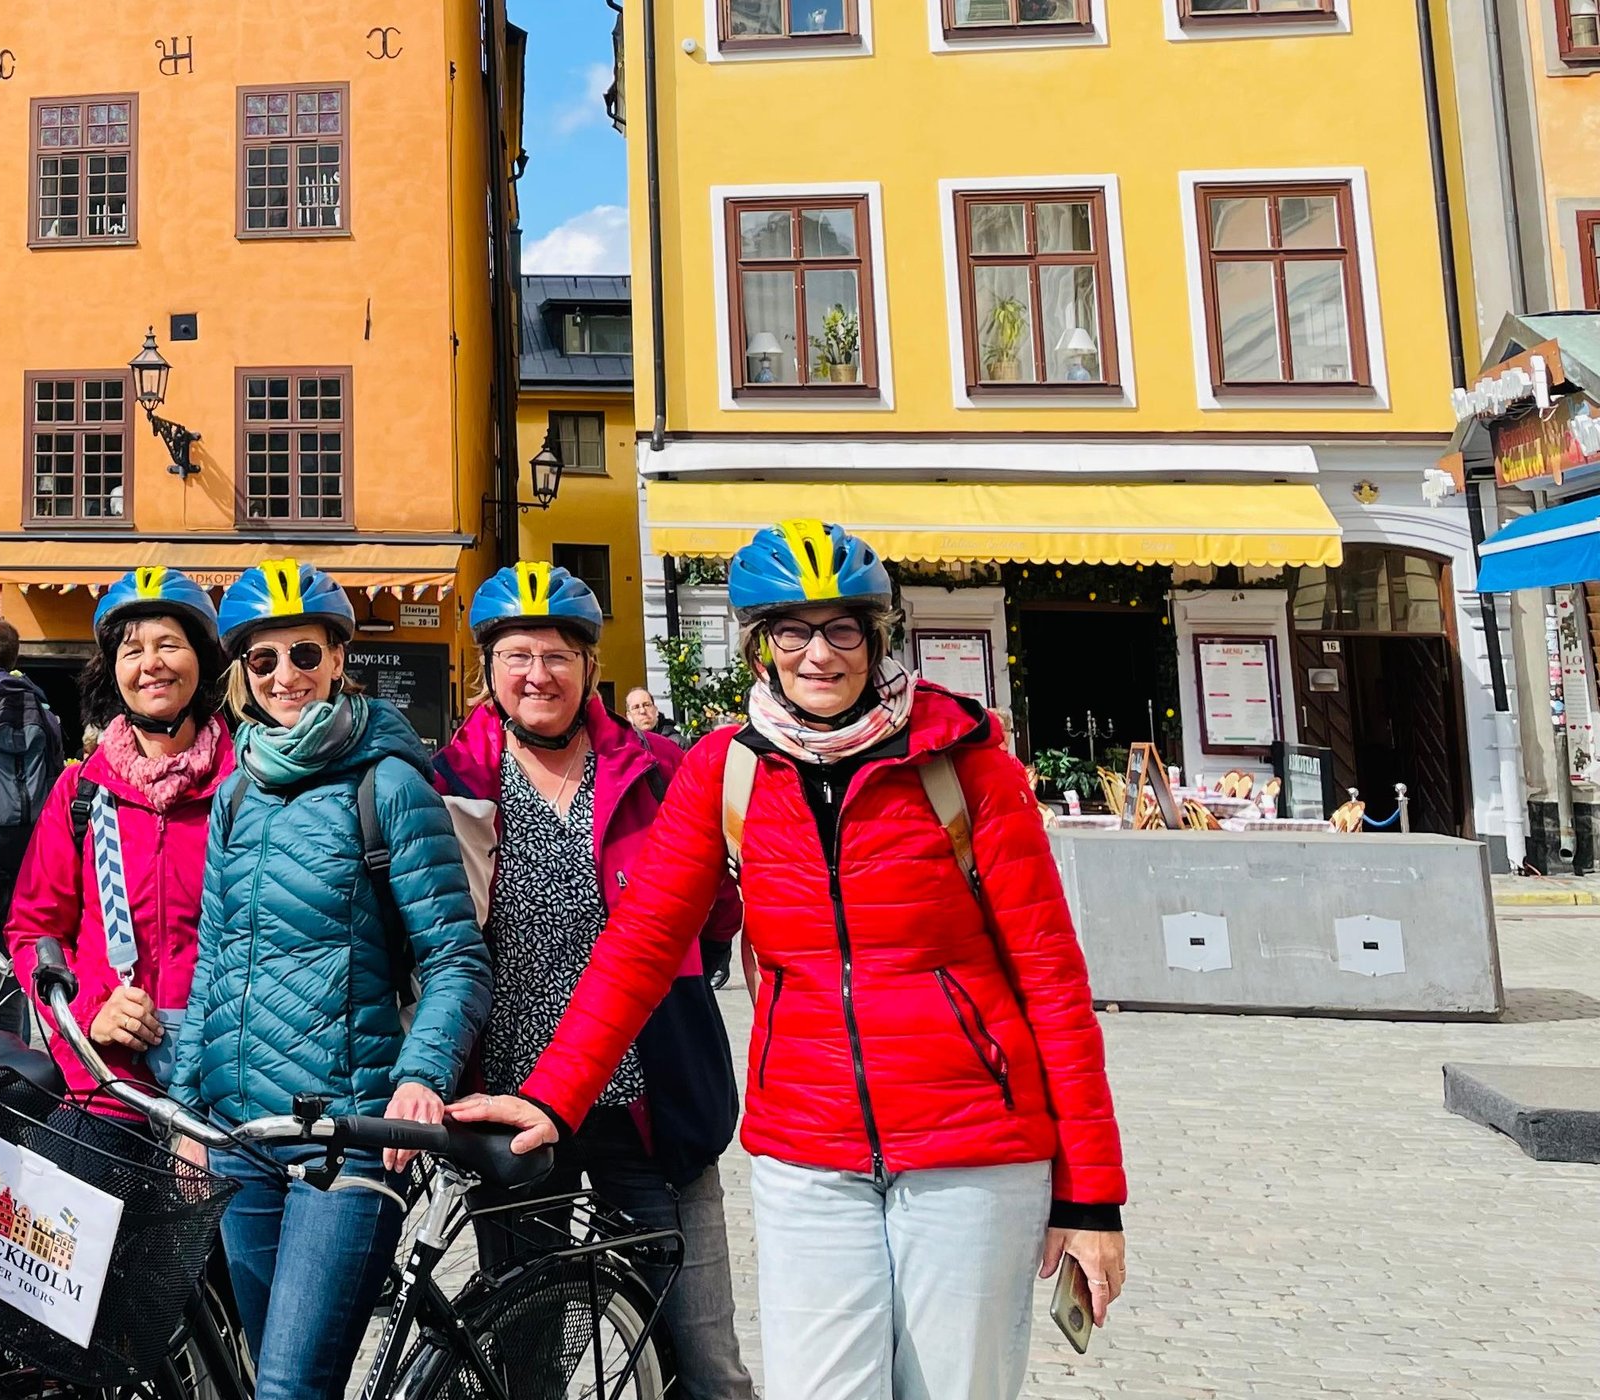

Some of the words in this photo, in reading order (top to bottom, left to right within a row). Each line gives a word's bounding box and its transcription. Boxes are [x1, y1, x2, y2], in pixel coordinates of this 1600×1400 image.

[405, 606, 438, 615] Stortorget
[1326, 642, 1337, 651] 16
[348, 653, 401, 666] DRYCKER
[17, 1276, 56, 1306] TOURS
